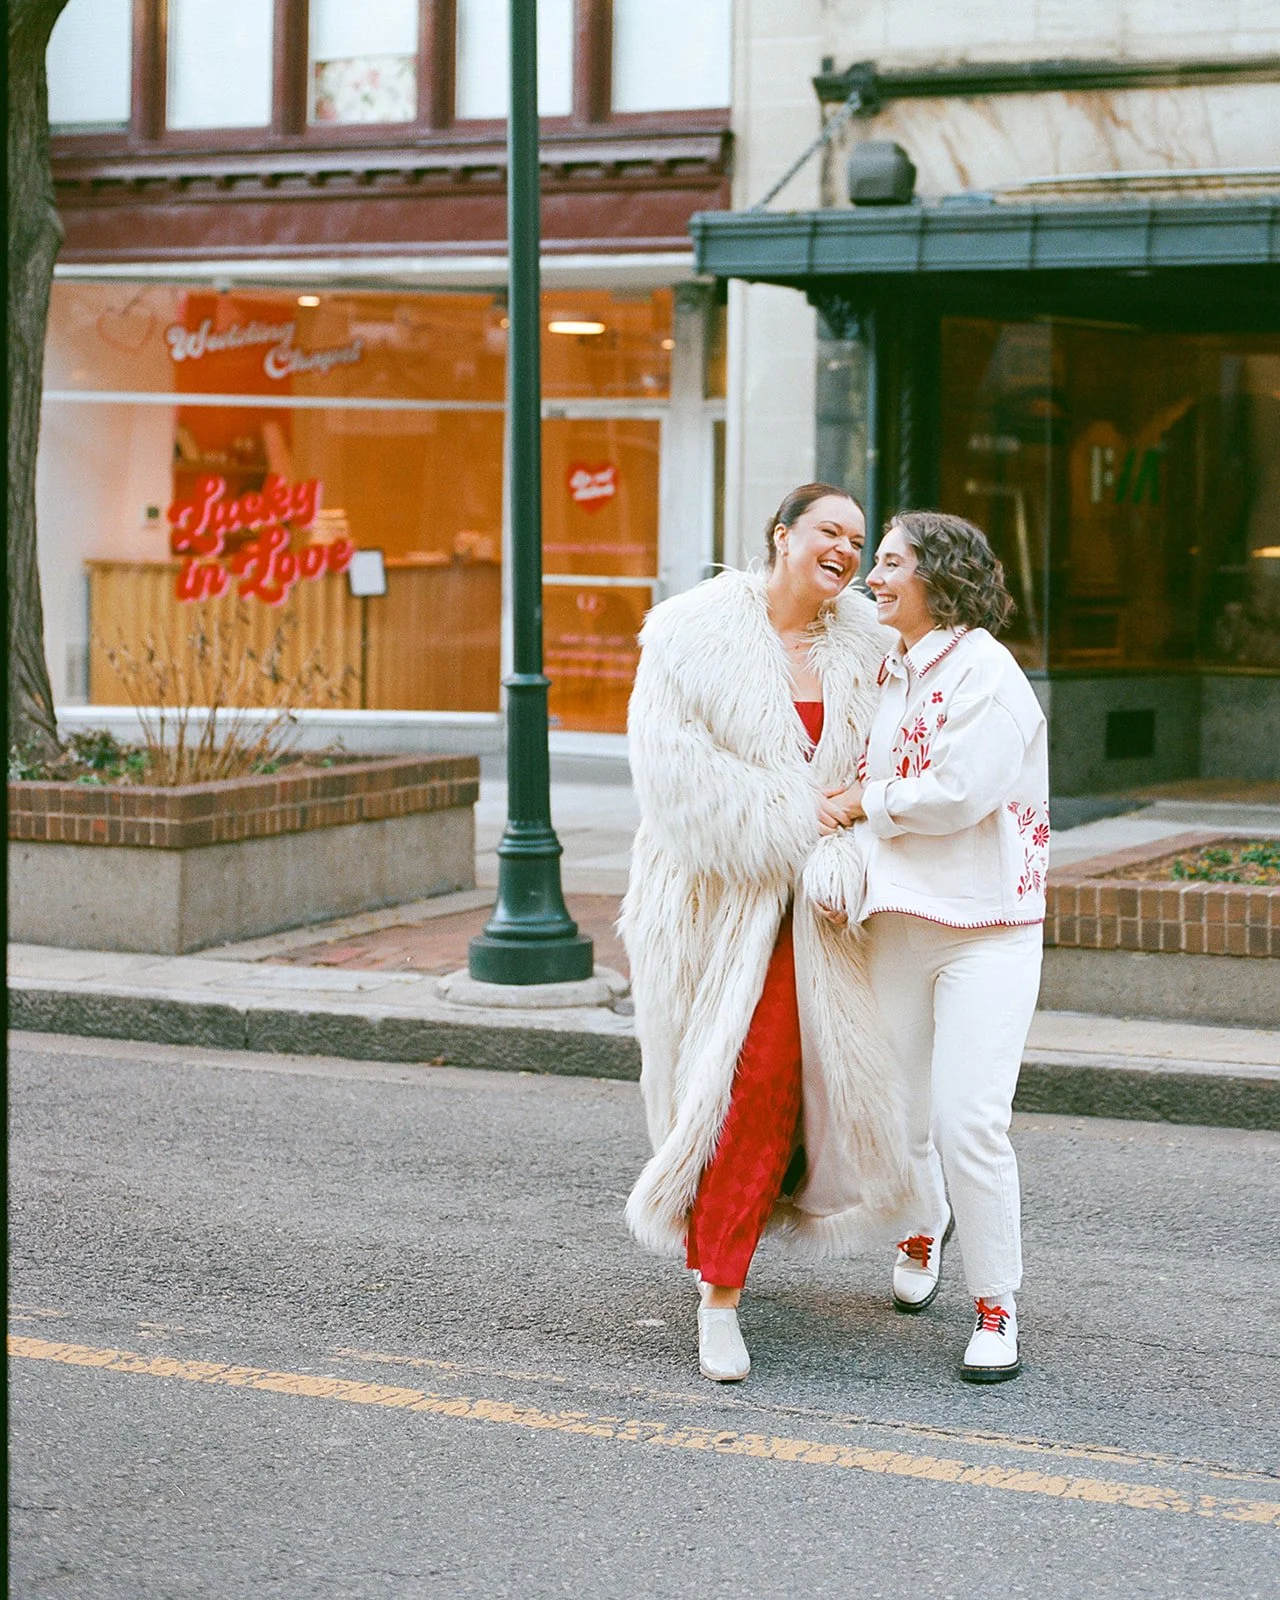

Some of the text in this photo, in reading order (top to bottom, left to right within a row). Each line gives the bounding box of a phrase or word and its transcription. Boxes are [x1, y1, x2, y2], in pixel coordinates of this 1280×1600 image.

[166, 318, 296, 362] Wedding
[167, 473, 323, 558] Lucky
[176, 525, 353, 607] in Love
